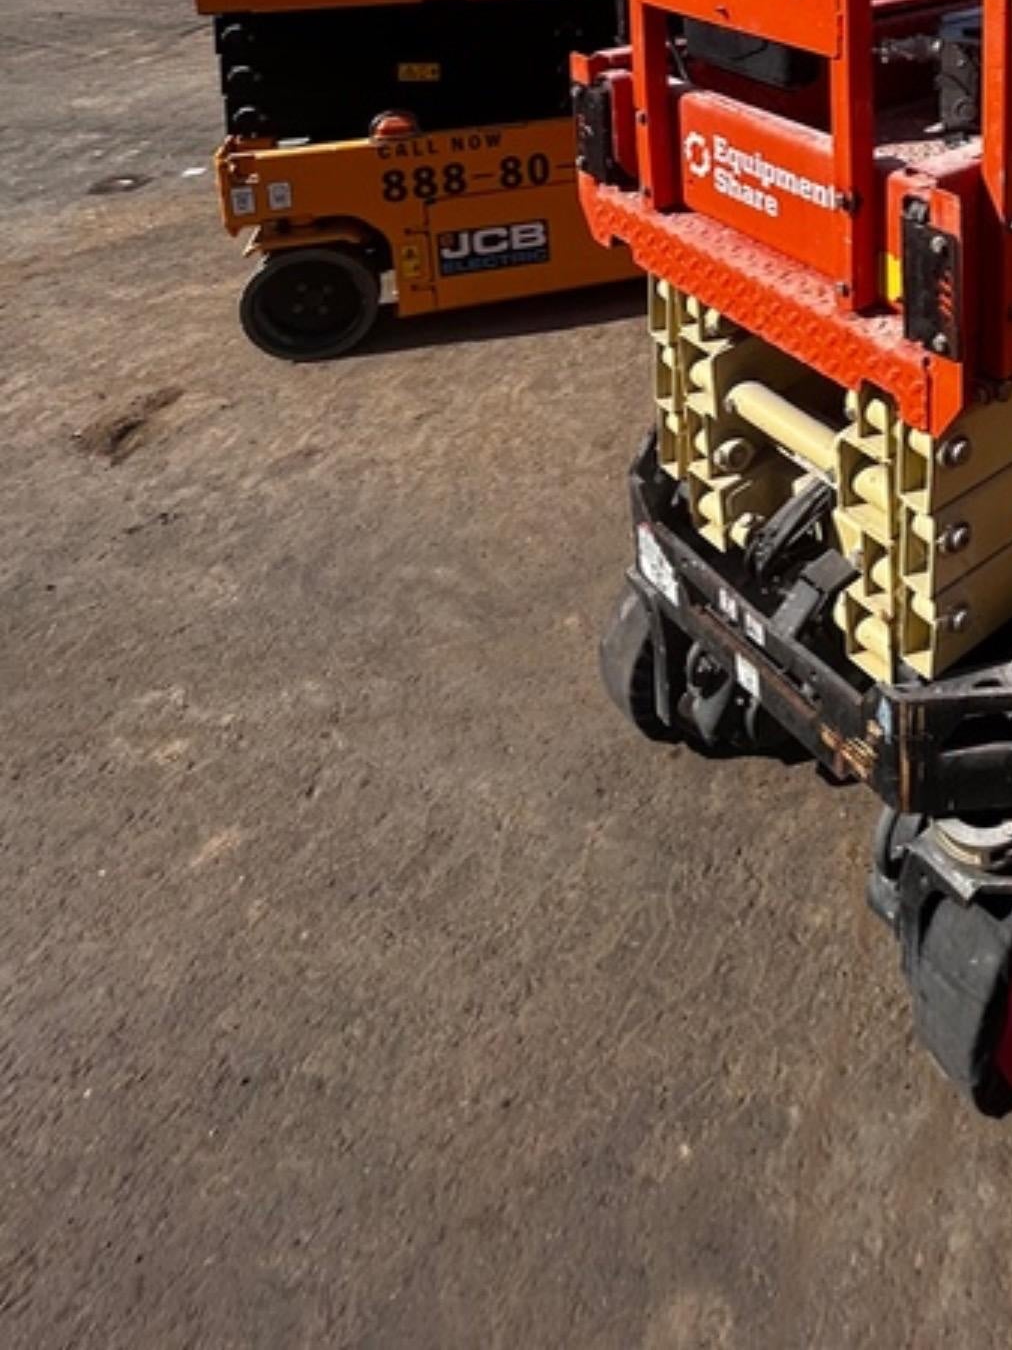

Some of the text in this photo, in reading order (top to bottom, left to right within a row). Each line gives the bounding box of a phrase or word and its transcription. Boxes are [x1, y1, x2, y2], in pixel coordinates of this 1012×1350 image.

[377, 133, 501, 160] CALL NOW
[713, 165, 779, 218] Share
[440, 221, 547, 259] JCB
